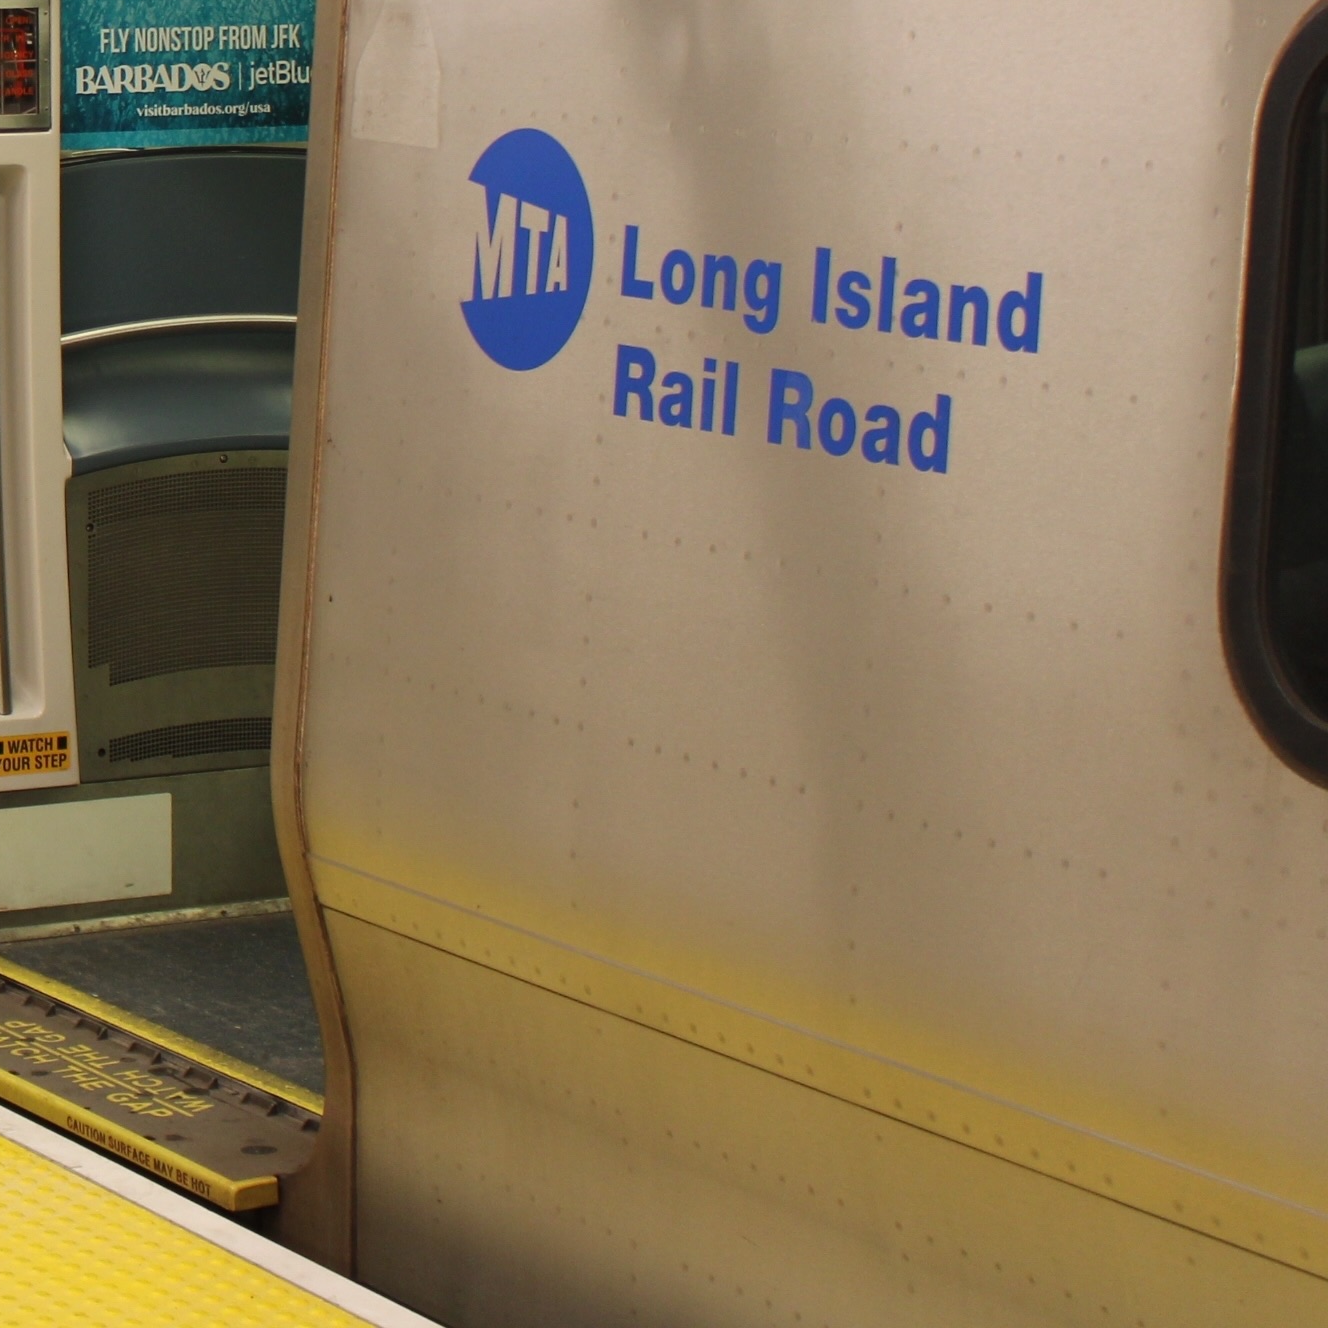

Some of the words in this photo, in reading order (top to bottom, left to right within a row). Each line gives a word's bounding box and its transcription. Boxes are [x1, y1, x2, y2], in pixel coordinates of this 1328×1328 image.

[100, 27, 130, 54] FLY
[134, 25, 214, 53] NONSTOP
[219, 24, 266, 51] FROM
[271, 24, 300, 49] JFK
[75, 61, 231, 95] BARBADOS
[248, 60, 314, 91] jetBlu
[136, 102, 271, 118] visitbarbados.org/usa
[471, 192, 569, 302] MTA
[620, 224, 782, 334] Long
[811, 246, 1044, 355] Island
[612, 343, 739, 437] Rail
[766, 367, 952, 475] Road
[7, 736, 53, 755] WATCH
[35, 753, 67, 770] STEP
[4, 1020, 66, 1043] GAP
[57, 1044, 120, 1070] THE
[52, 1064, 115, 1091] THE
[106, 1092, 174, 1118] GAP
[116, 1070, 214, 1112] WATCH
[66, 1115, 106, 1145] CAUTION
[108, 1135, 151, 1167] SURFACE
[153, 1157, 174, 1178] MAY
[176, 1169, 189, 1186] BE
[191, 1177, 212, 1198] HOT
